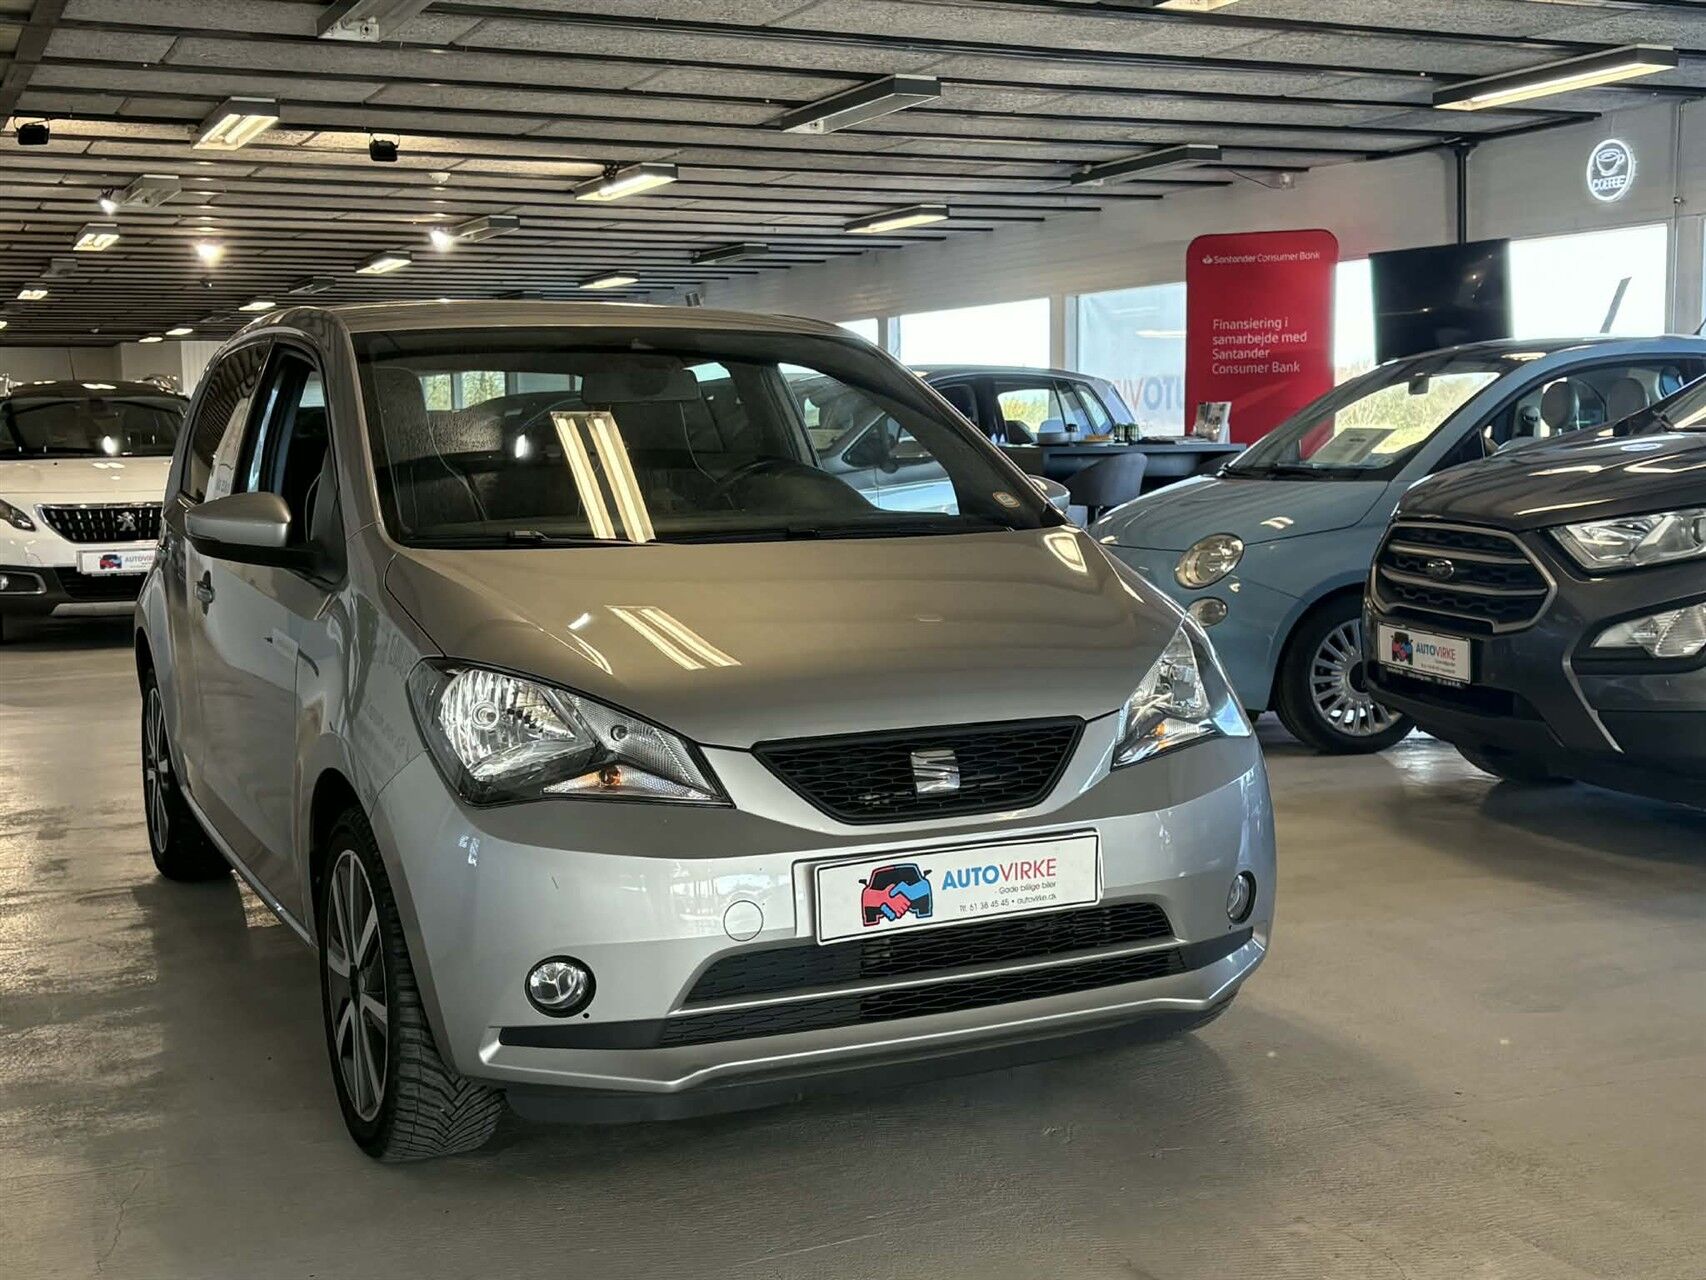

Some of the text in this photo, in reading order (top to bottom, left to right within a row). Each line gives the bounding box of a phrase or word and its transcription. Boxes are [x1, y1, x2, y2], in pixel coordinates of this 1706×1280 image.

[1214, 251, 1320, 264] Santander Consumer Bank
[1213, 317, 1288, 331] Finansiering i
[1212, 332, 1307, 346] samarbejde med
[1212, 349, 1270, 360] Santander
[1212, 361, 1300, 374] Consumer Bank
[1416, 643, 1456, 661] AUTOVIRKE
[942, 859, 1057, 890] AUTOVIRKE
[990, 900, 999, 908] 45
[1001, 898, 1010, 907] 45
